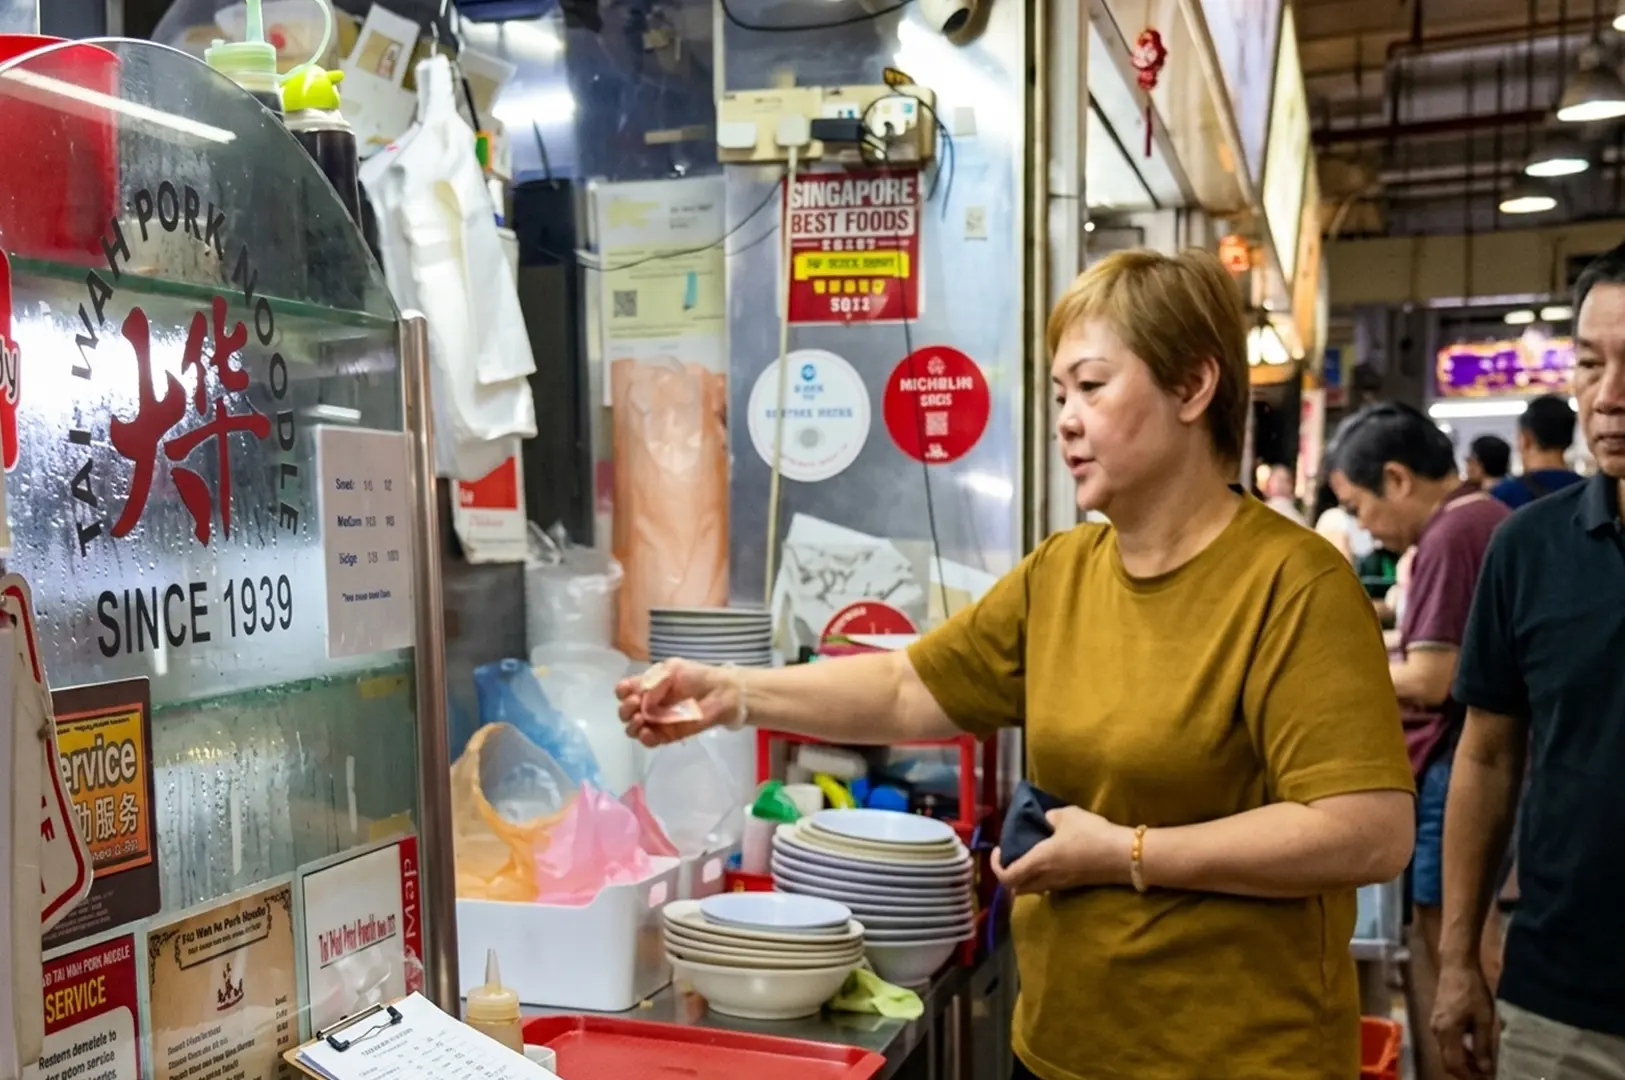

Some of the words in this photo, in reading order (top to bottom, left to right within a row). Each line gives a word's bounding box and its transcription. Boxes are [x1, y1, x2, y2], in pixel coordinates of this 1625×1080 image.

[134, 180, 225, 261] PORK
[793, 178, 915, 208] SINGAPORE
[793, 212, 837, 233] BEST
[846, 209, 909, 232] FOODS
[71, 216, 131, 381] WAH
[231, 244, 299, 536] NOODLE
[900, 376, 973, 391] MICHELIN
[69, 430, 103, 557] TAI
[98, 581, 211, 657] SINCE
[223, 574, 294, 638] 1939
[60, 737, 137, 791] ervice
[45, 974, 107, 1024] SERVICE
